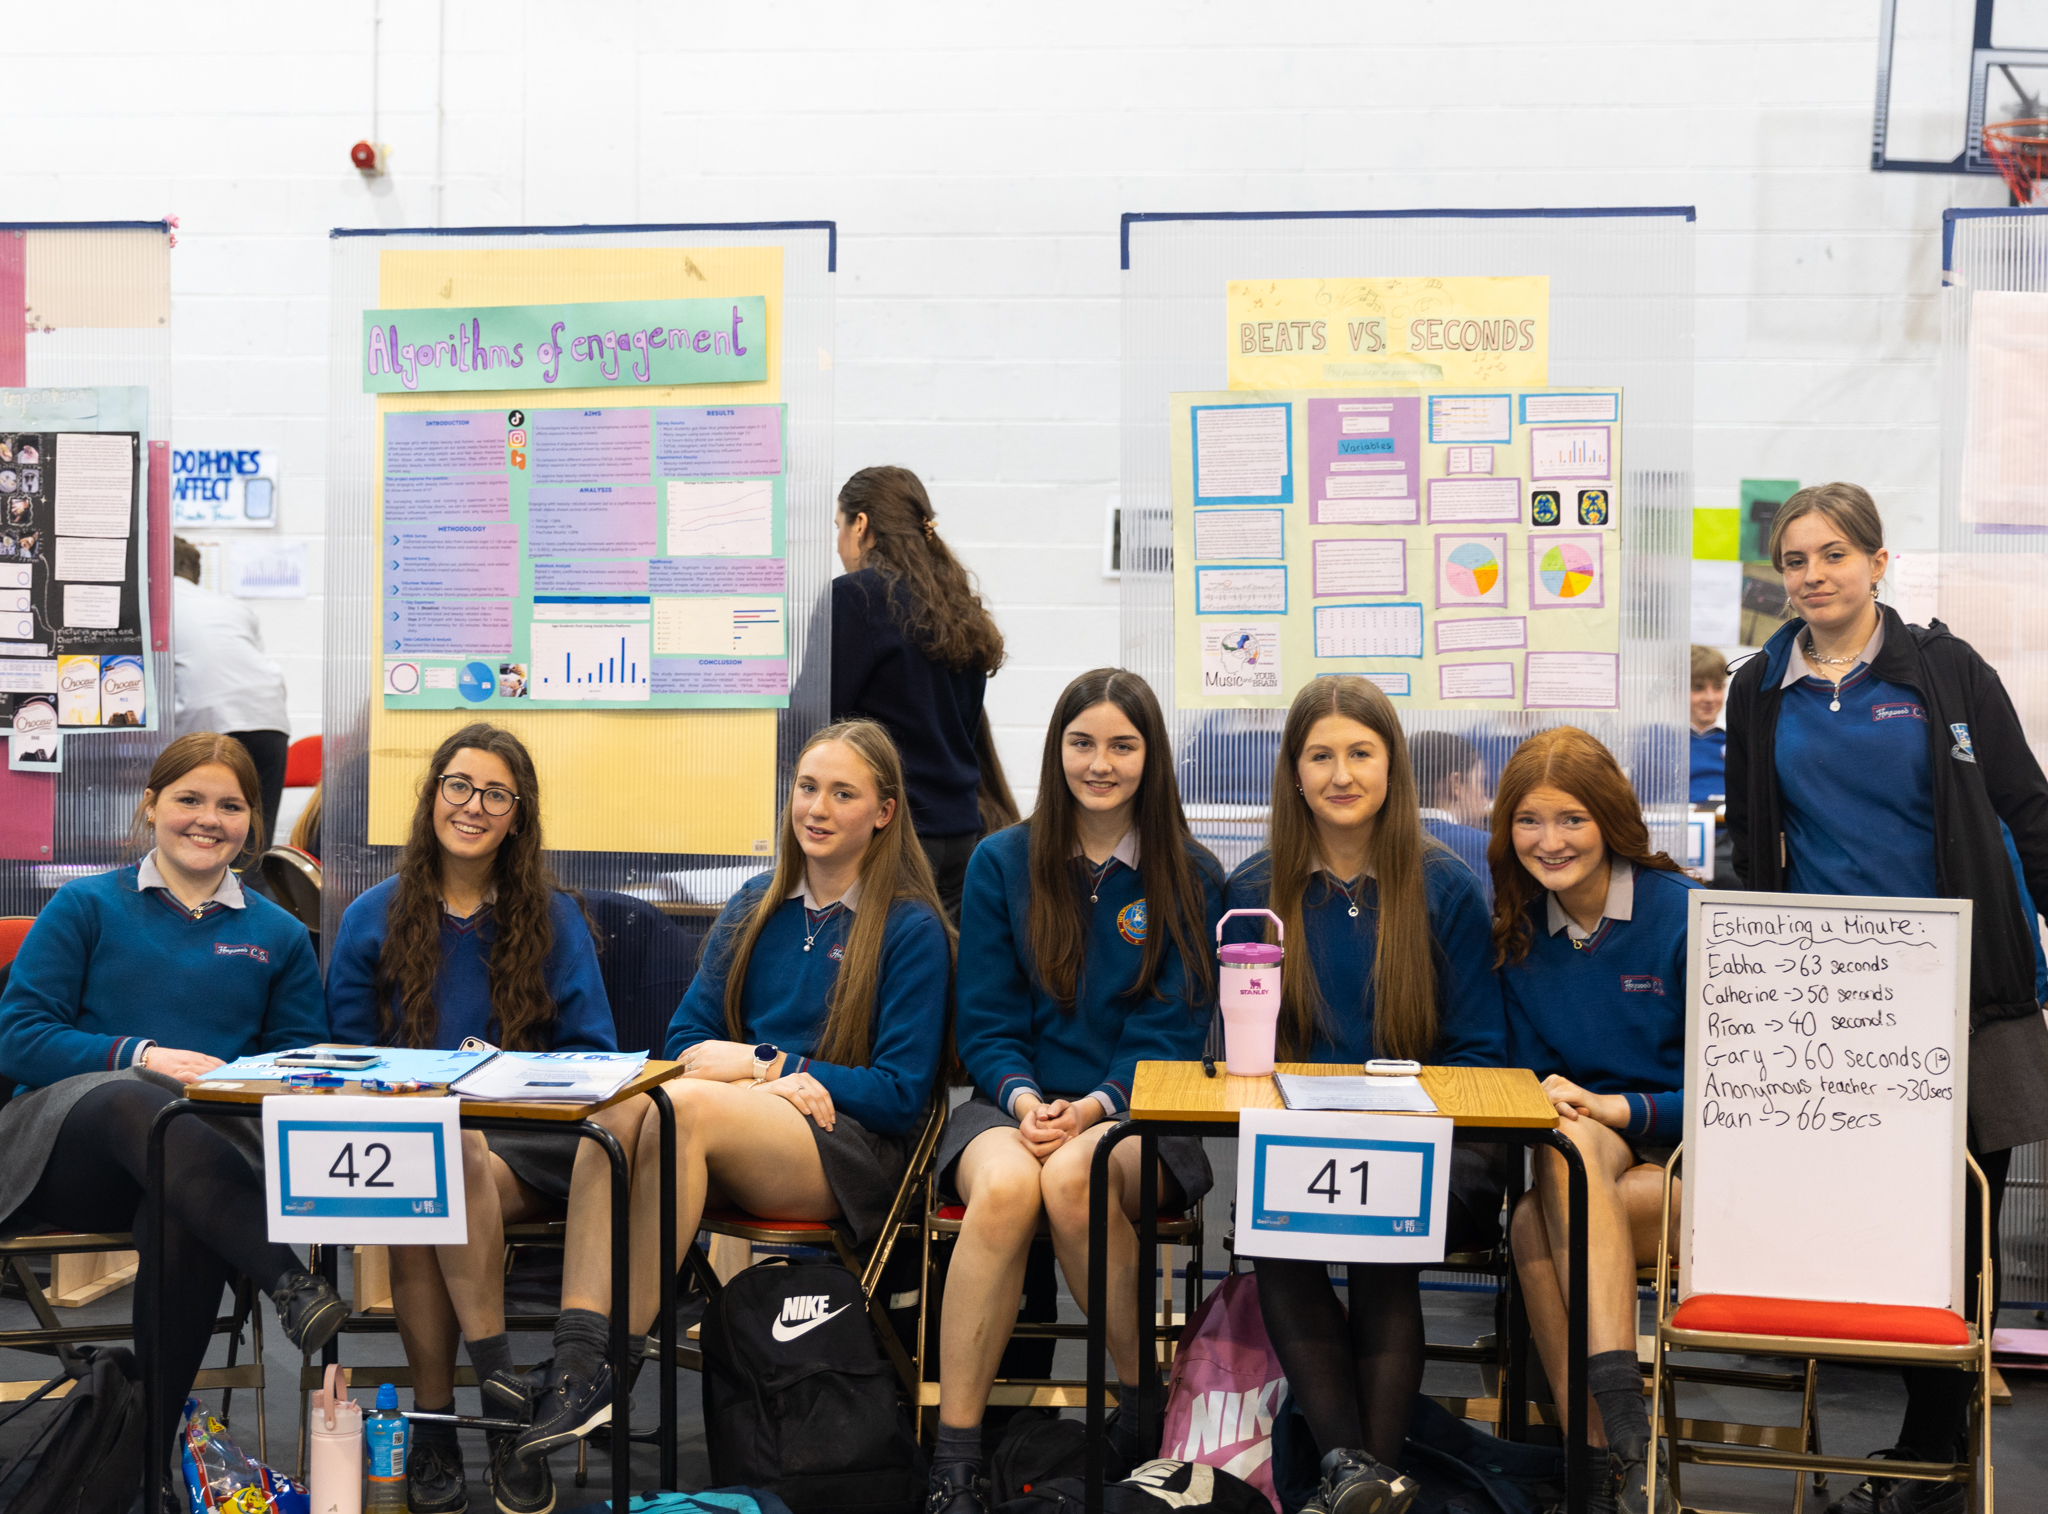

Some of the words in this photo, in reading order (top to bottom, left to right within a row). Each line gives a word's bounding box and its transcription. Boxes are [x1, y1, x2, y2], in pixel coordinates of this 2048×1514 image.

[368, 318, 523, 389] Algorithms
[537, 322, 565, 383] of
[571, 306, 746, 382] engagement
[1241, 322, 1326, 353] BEATS
[1348, 321, 1386, 352] VS.
[1411, 319, 1535, 351] SECONDS
[1341, 442, 1391, 452] Variables
[173, 450, 195, 474] DO
[199, 450, 260, 474] PHONES
[173, 478, 232, 500] AFFECT
[61, 677, 97, 690] Choceur
[105, 679, 141, 692] Choceur
[1206, 671, 1243, 687] Music
[16, 717, 53, 730] Choceur
[1713, 912, 1813, 950] Estimating
[1821, 920, 1833, 933] a
[1844, 915, 1925, 935] Minute:
[1800, 954, 1822, 976] 63
[1831, 955, 1889, 975] seconds
[1703, 984, 1779, 1005] Catherine
[1808, 985, 1828, 1003] 50
[1838, 984, 1893, 1002] seconds
[1788, 1010, 1816, 1036] 40
[1831, 1010, 1896, 1030] seconds
[1705, 1045, 1767, 1081] Gary
[1805, 1040, 1833, 1069] 60
[1844, 1046, 1921, 1069] seconds
[1704, 1072, 1812, 1114] Anonymous
[1821, 1076, 1877, 1095] teacher
[1703, 1100, 1751, 1128] Dean
[329, 1142, 394, 1187] 42
[1307, 1159, 1369, 1205] 41
[782, 1295, 829, 1321] NIKE
[1184, 1376, 1288, 1462] NIK
